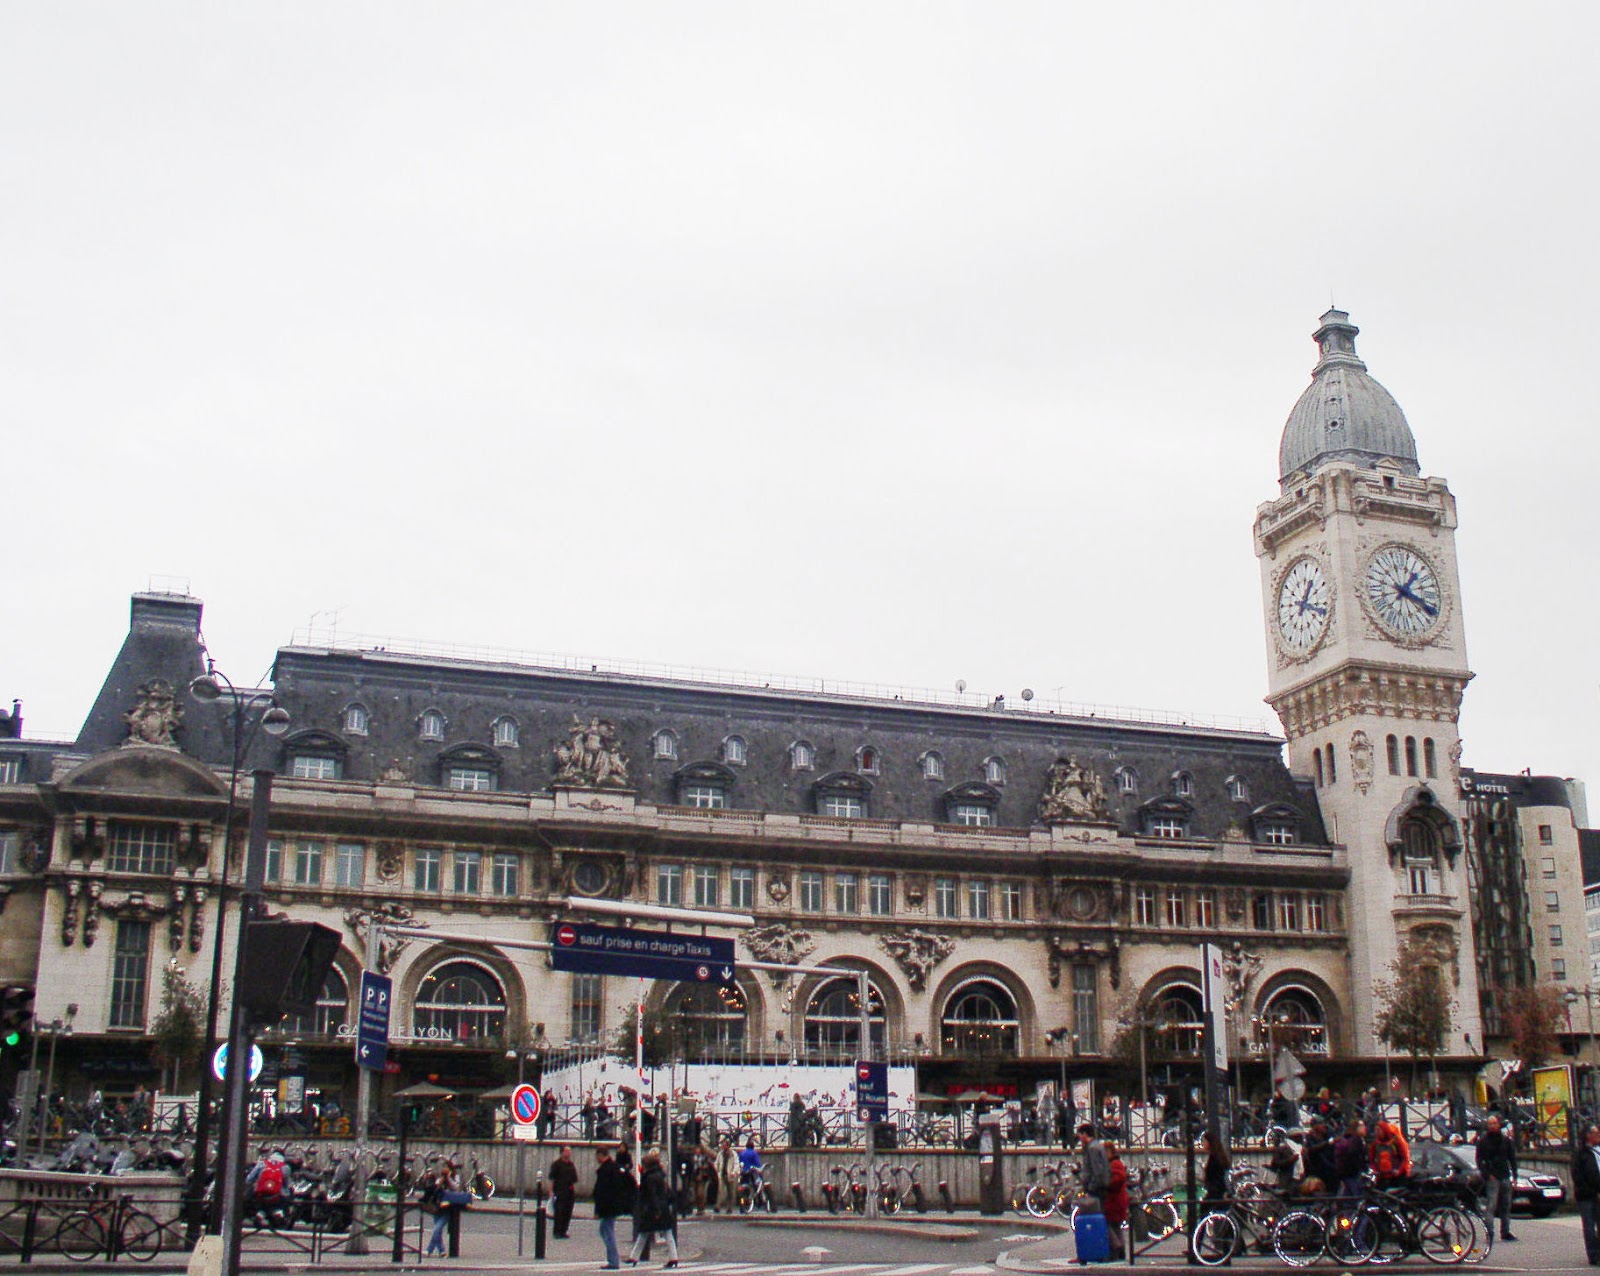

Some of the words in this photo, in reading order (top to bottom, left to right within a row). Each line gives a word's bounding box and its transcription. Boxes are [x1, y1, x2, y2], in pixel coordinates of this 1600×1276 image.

[1476, 783, 1510, 794] HOTEL
[580, 934, 603, 945] sauf
[606, 936, 632, 949] prise
[634, 940, 648, 950] en
[650, 939, 685, 956] charge
[685, 942, 712, 956] Taxis
[367, 987, 375, 1001] P
[379, 991, 387, 1005] P
[338, 1023, 358, 1036] GA
[412, 1026, 452, 1039] LYON
